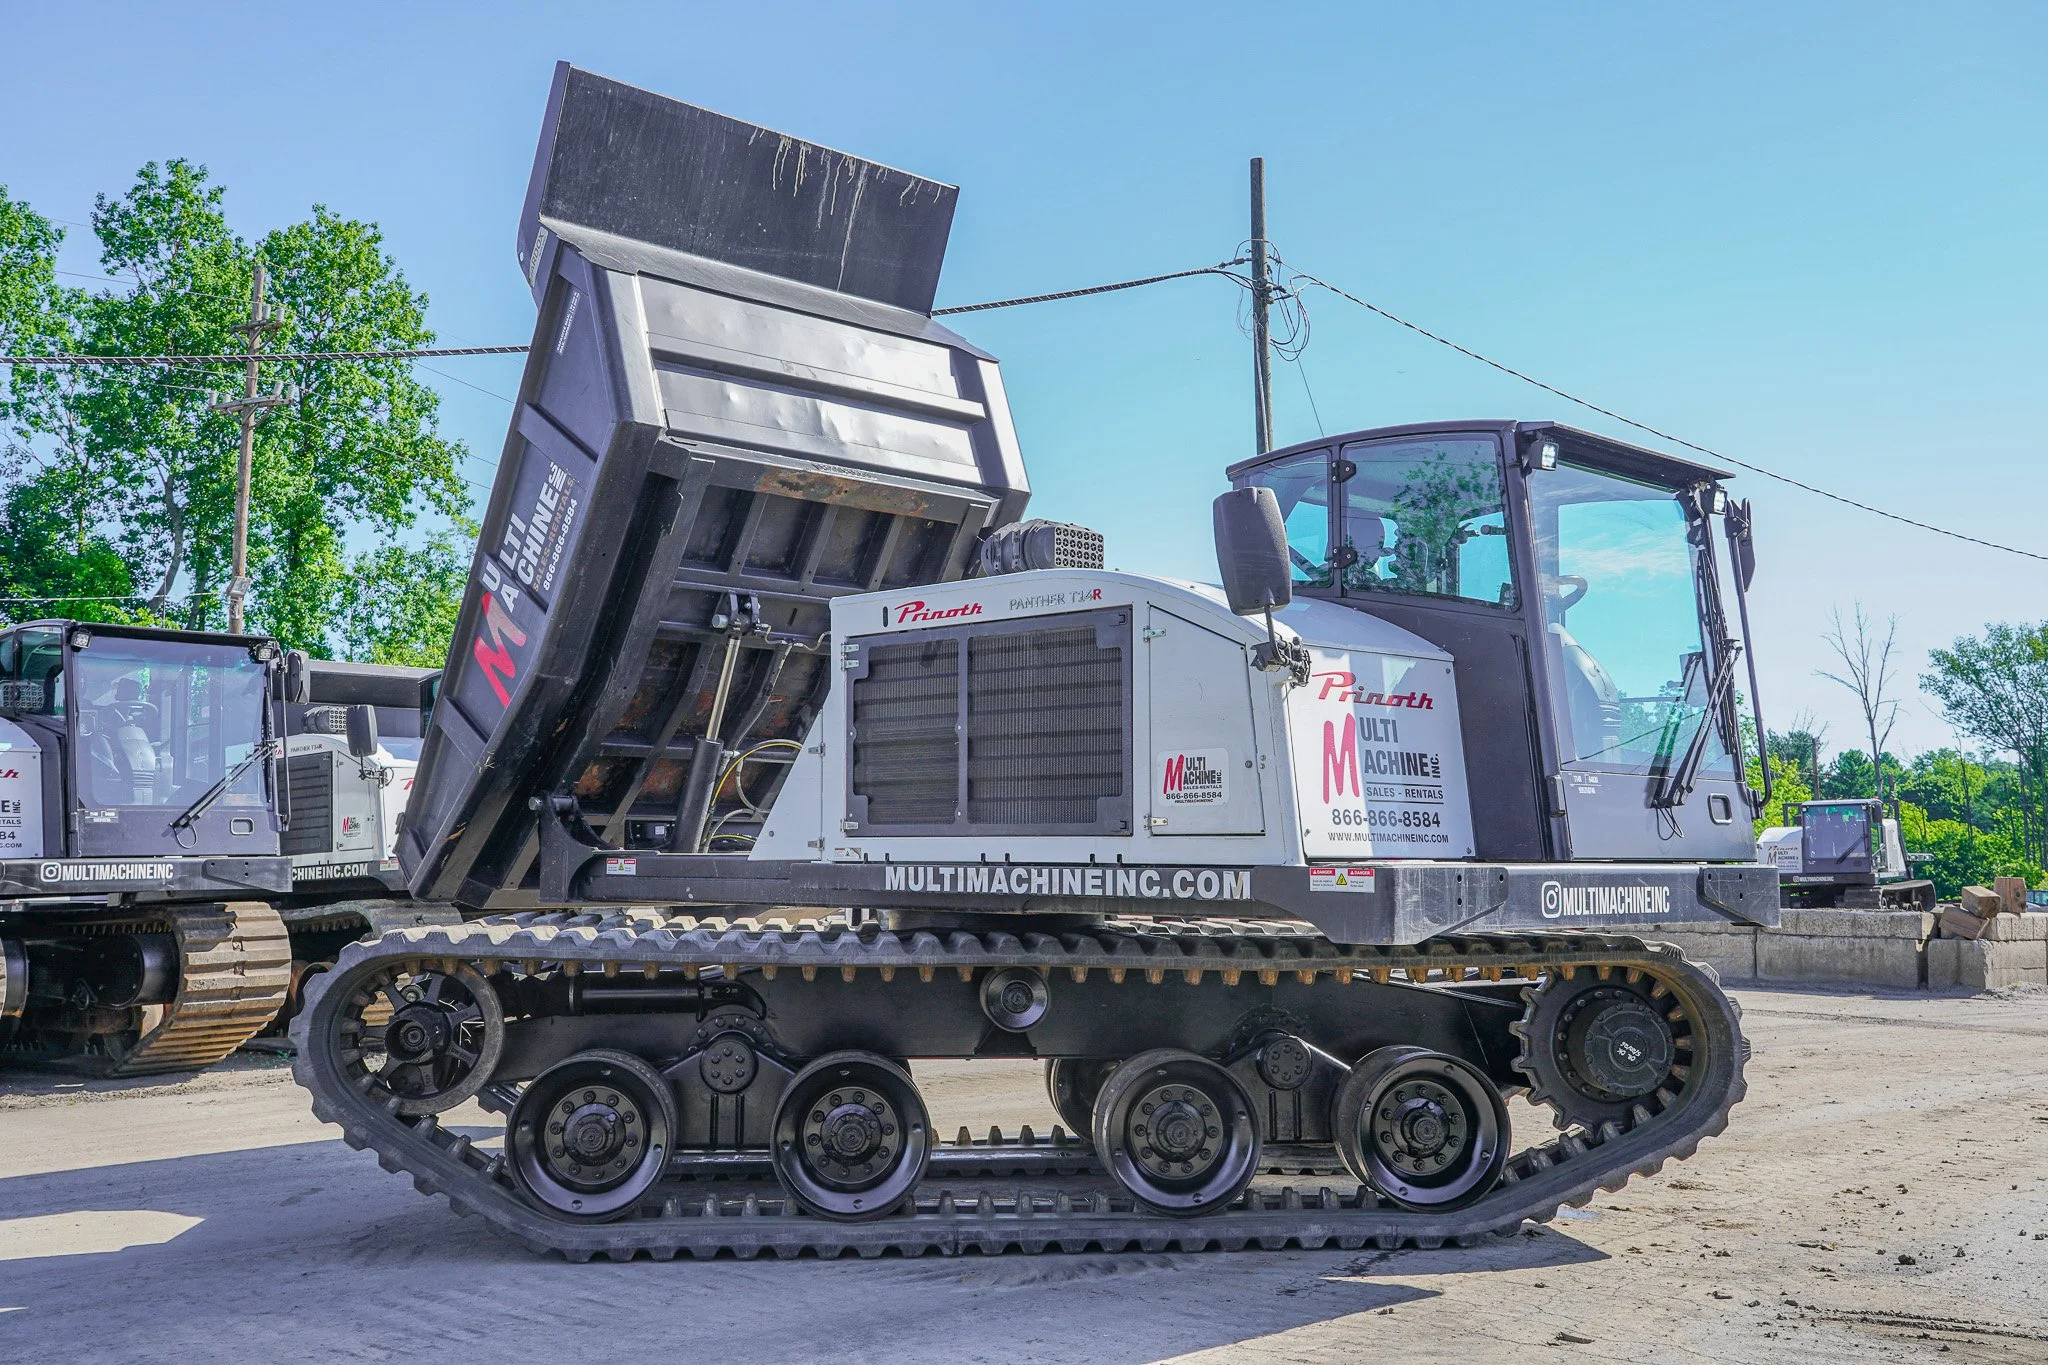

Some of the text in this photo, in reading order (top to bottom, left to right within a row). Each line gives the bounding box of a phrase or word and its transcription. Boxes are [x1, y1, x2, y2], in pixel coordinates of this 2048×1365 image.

[543, 498, 578, 591] 866-866-8584
[894, 600, 983, 624] Prinoth
[1009, 593, 1066, 610] PANTHER
[1312, 671, 1434, 710] Prinoth
[1430, 753, 1441, 779] INC.
[1366, 786, 1396, 798] SALES
[1404, 788, 1444, 800] RENTALS
[1331, 808, 1441, 828] 866-866-8584
[1327, 831, 1450, 844] WWW.MULTIMACHINEINC.COM
[62, 863, 174, 881] MULTIMACHINEINC
[885, 865, 1251, 900] MULTIMACHINEINC.COM
[1563, 885, 1671, 916] MULTIMACHINEINC
